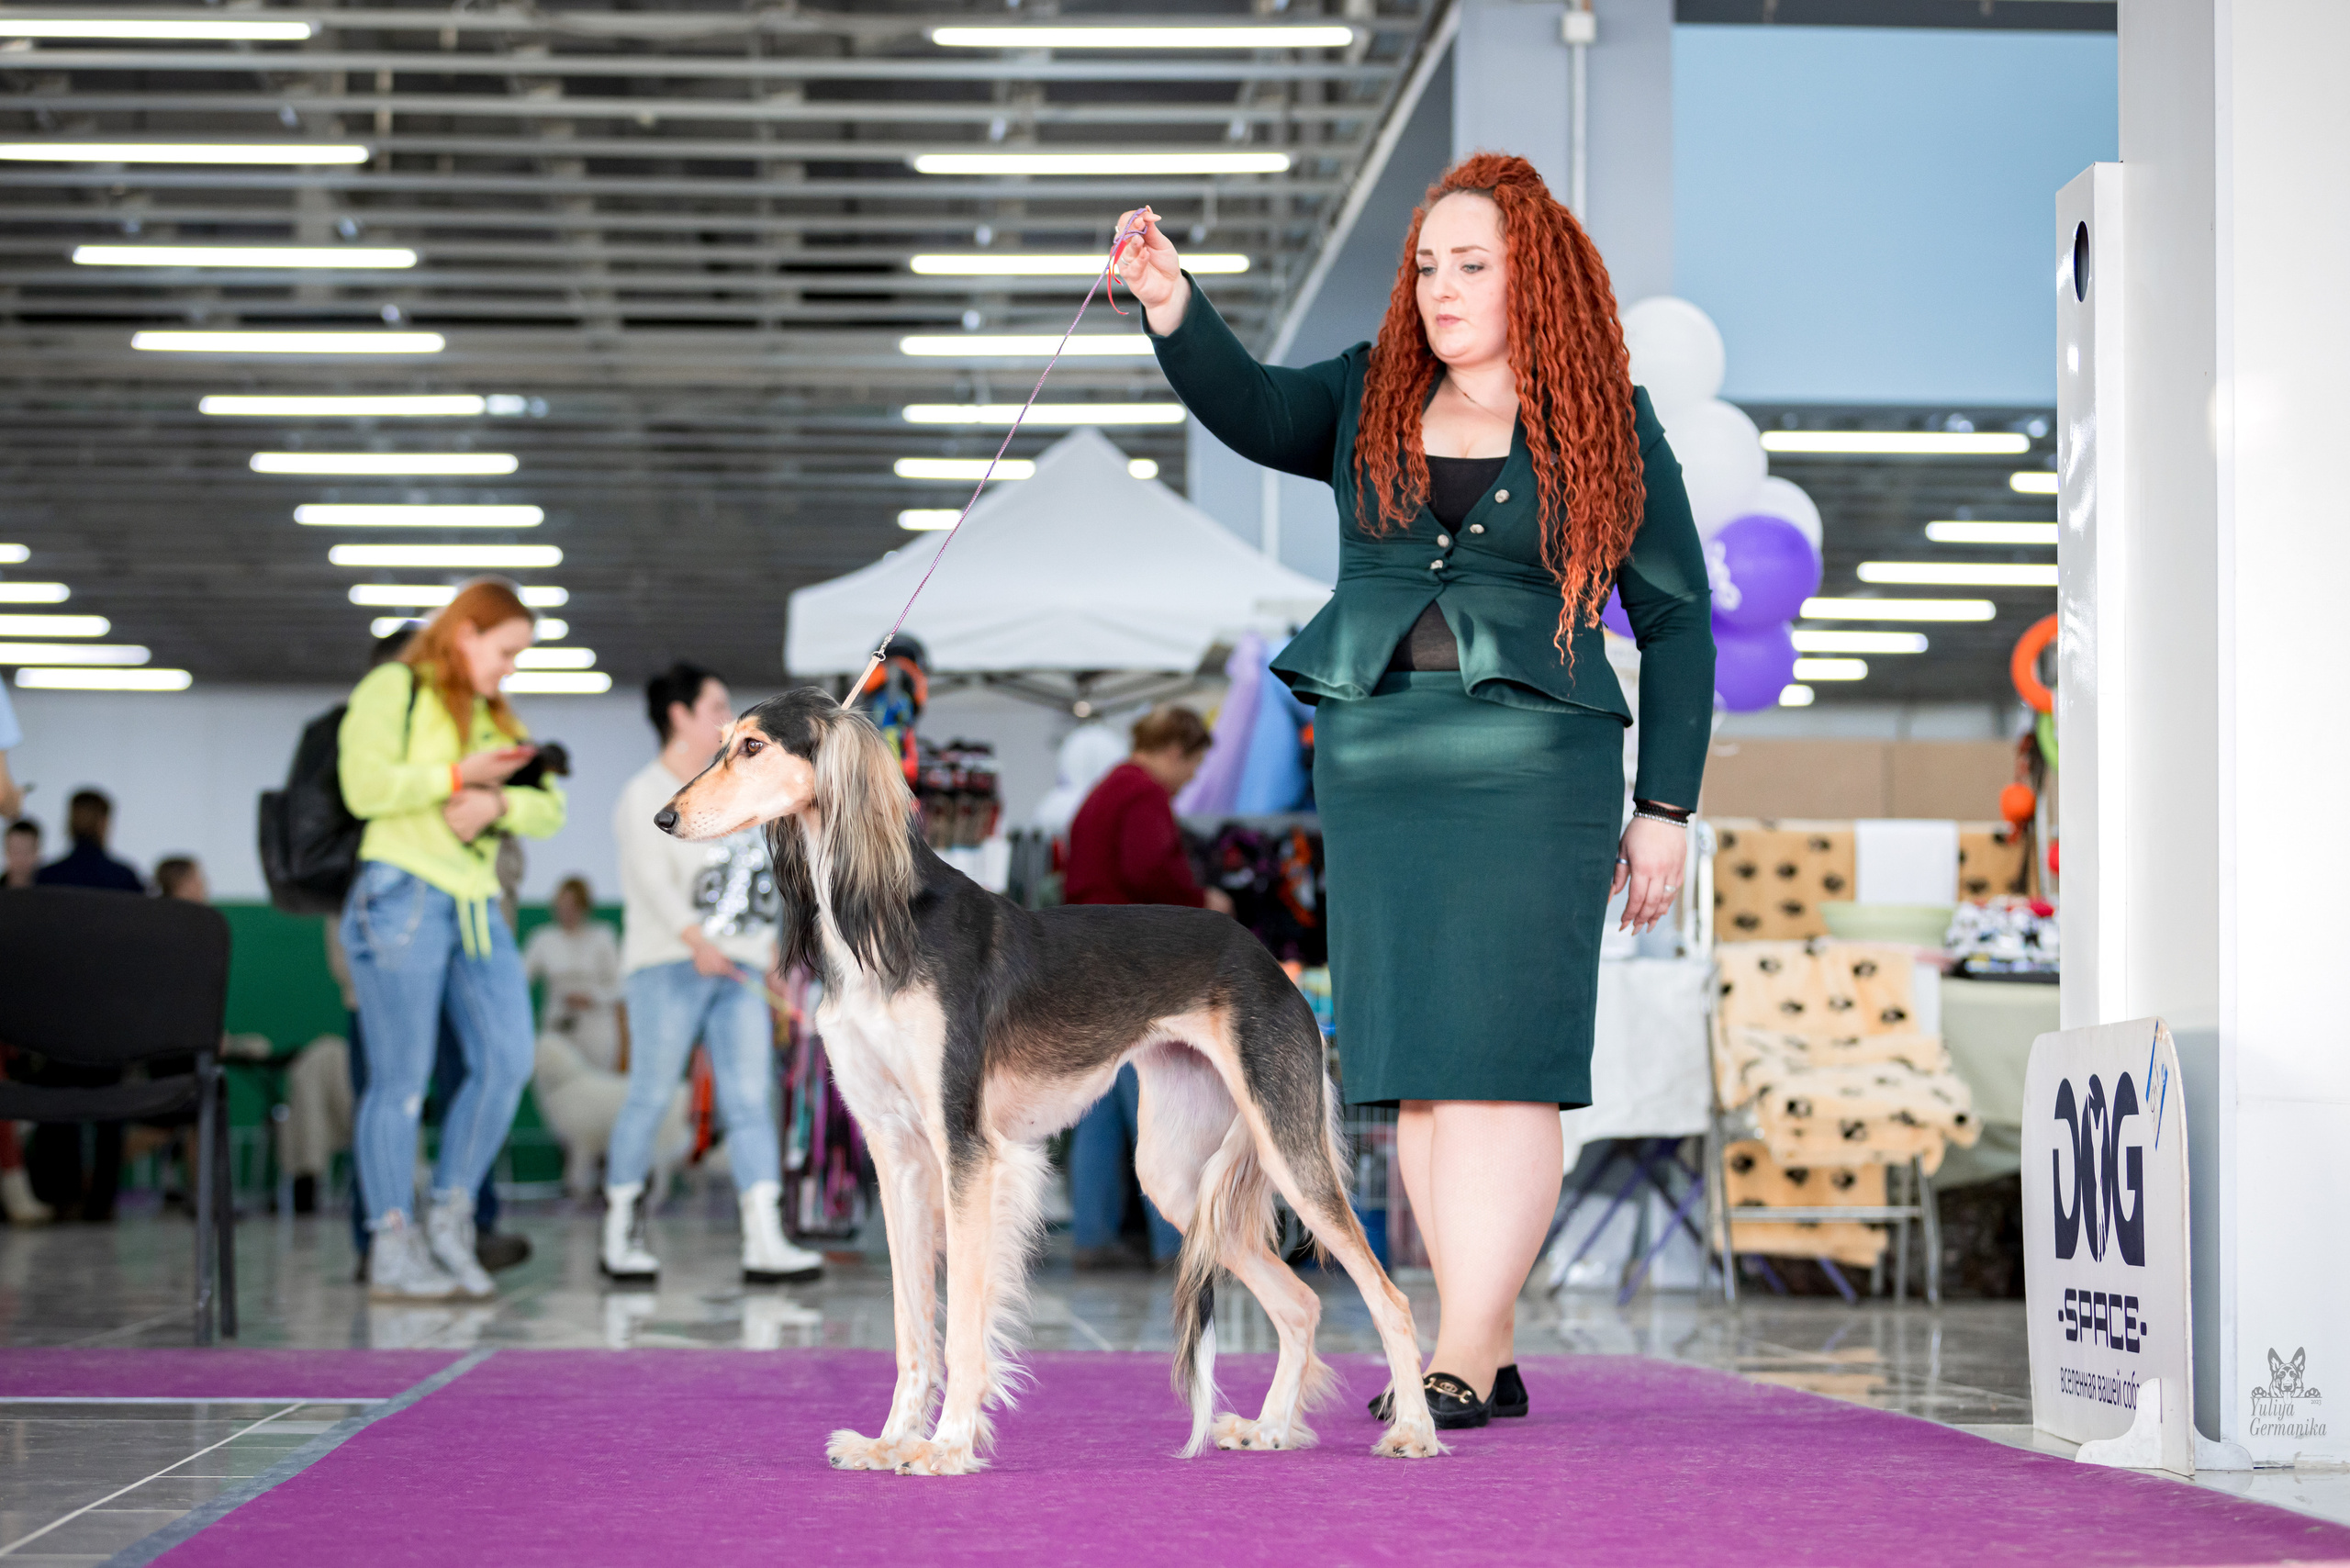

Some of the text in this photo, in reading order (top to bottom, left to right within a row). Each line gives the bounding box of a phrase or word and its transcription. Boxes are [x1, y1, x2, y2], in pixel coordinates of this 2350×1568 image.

[2053, 1071, 2145, 1267] DOG
[2060, 1366, 2140, 1410] вселенная вашей соб
